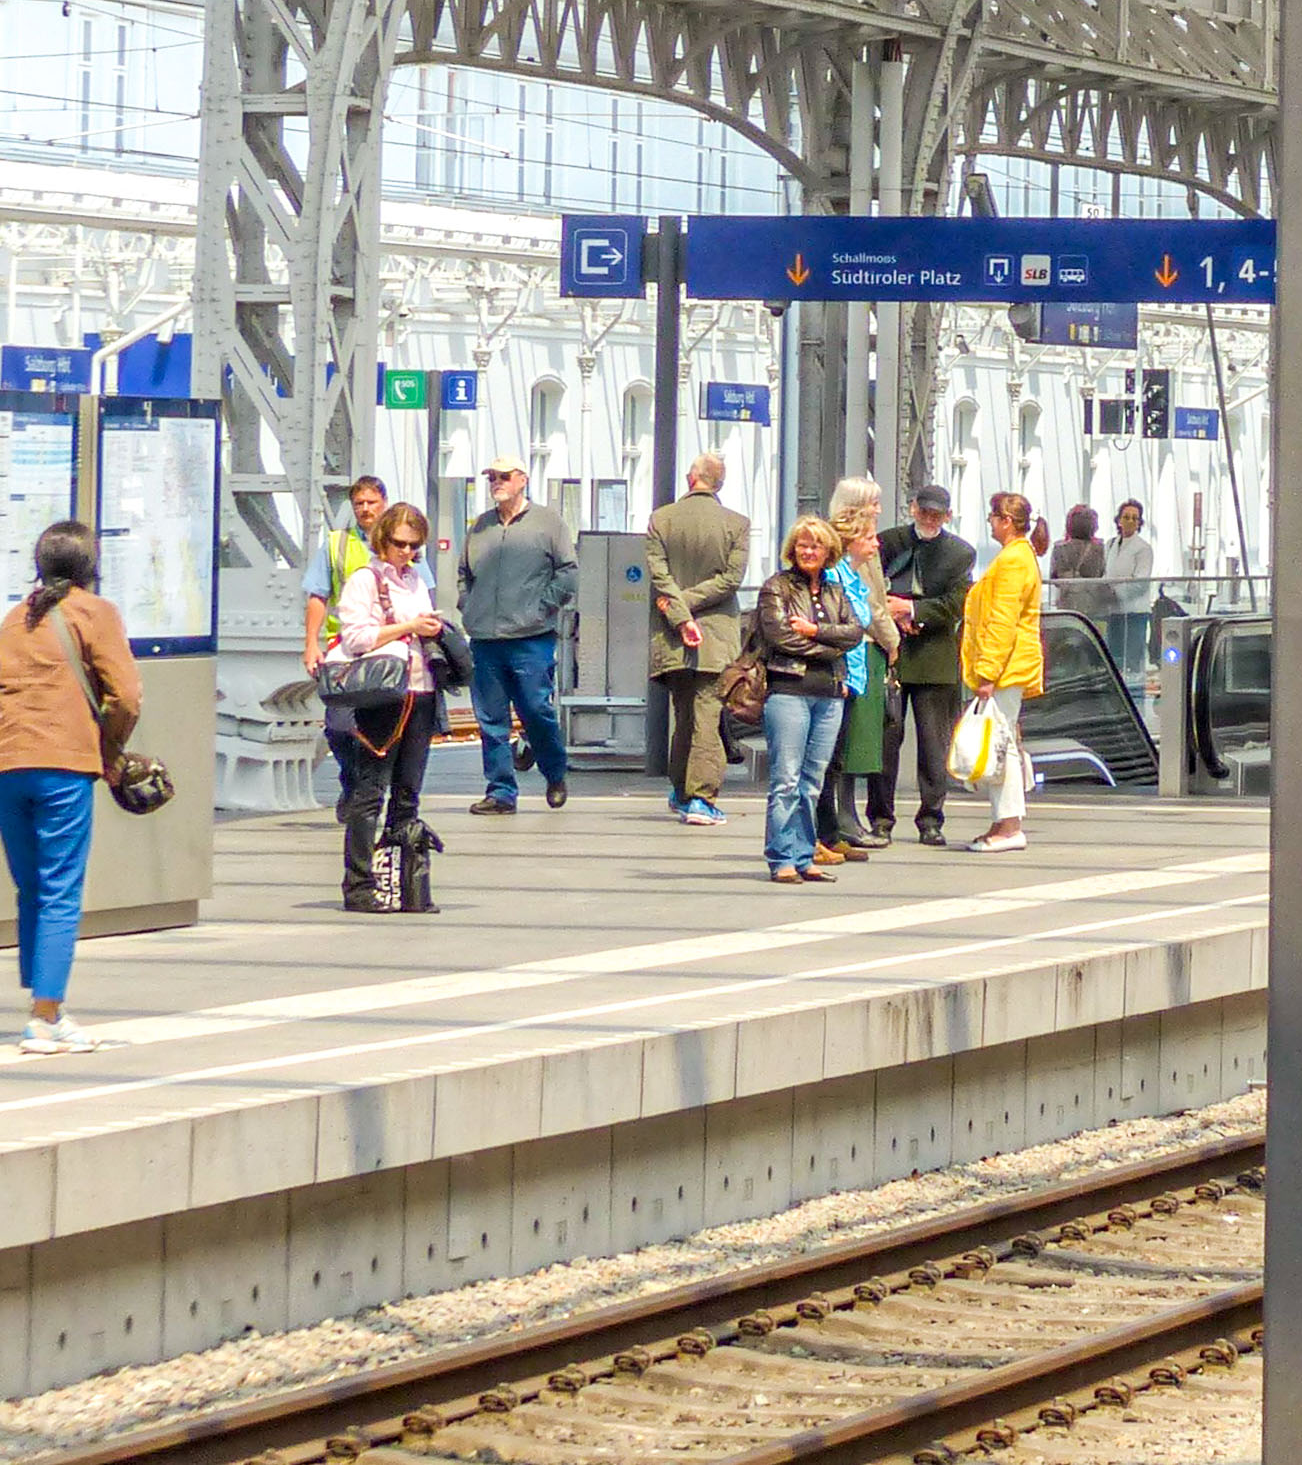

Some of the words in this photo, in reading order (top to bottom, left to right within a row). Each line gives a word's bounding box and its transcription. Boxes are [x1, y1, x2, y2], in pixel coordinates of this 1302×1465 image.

[832, 252, 897, 264] Schallmoos
[831, 269, 915, 285] Südtiroler
[920, 269, 961, 285] Platz
[1024, 268, 1048, 280] SLB
